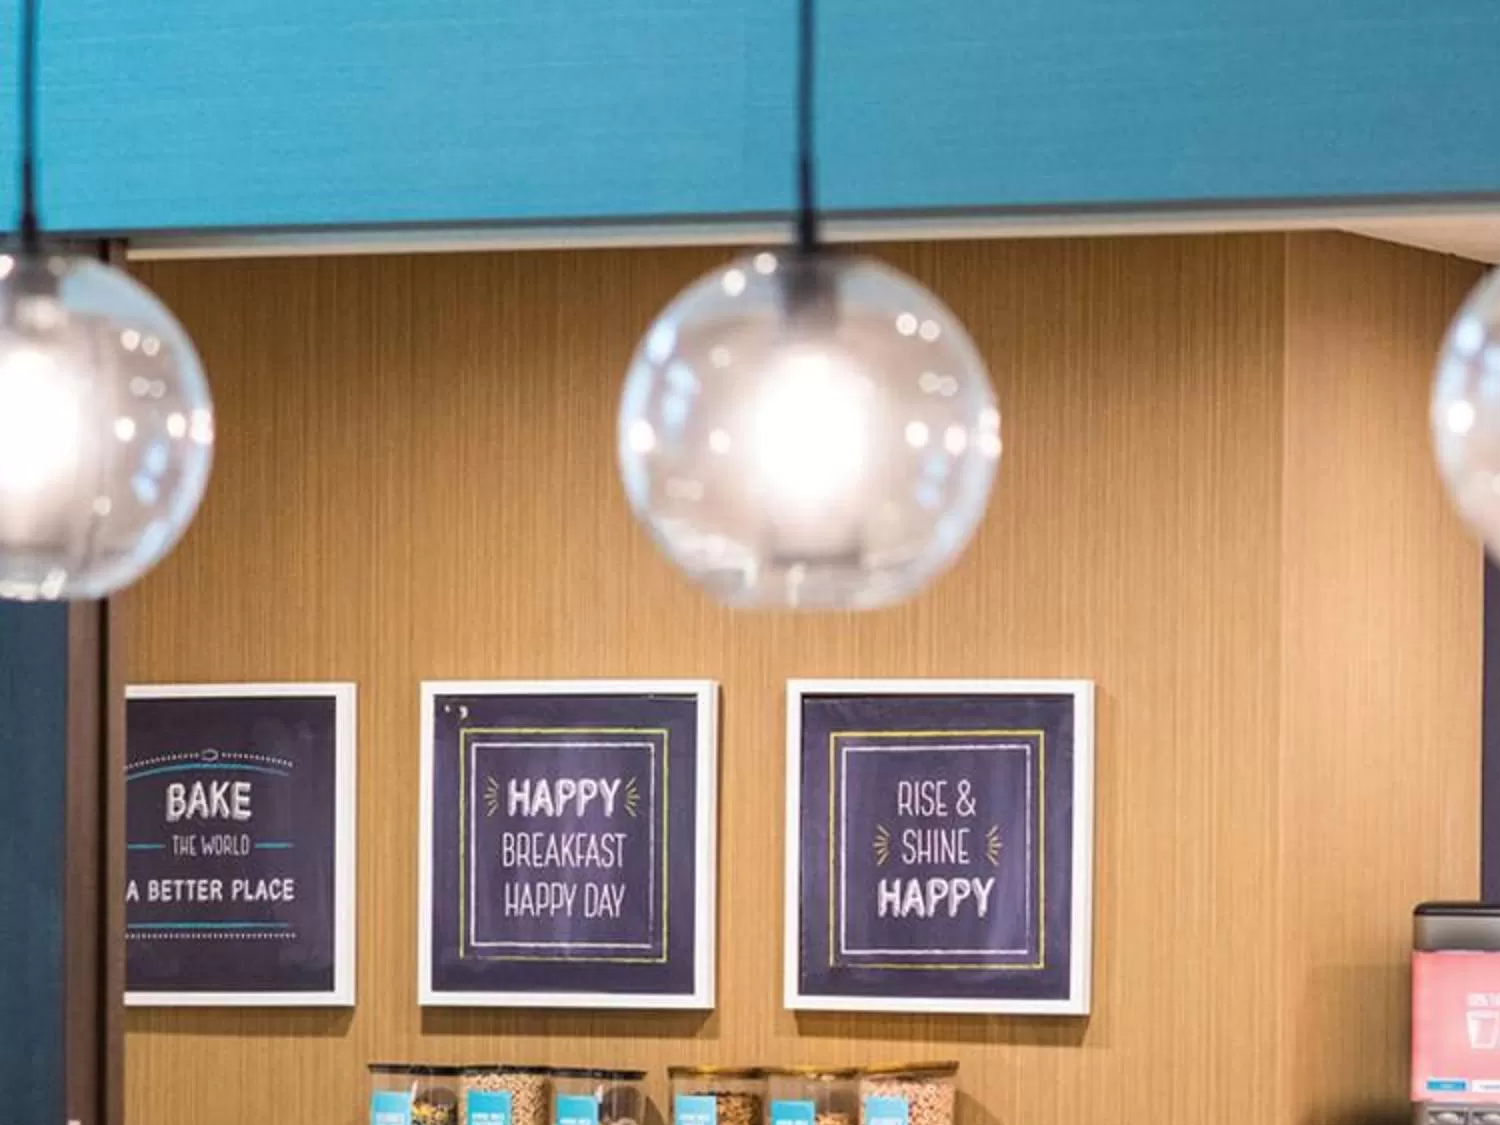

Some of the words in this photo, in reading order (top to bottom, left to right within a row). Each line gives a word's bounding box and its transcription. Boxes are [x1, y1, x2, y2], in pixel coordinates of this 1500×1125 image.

[165, 780, 253, 822] BAKE
[507, 777, 622, 818] HAPPY
[897, 780, 949, 817] RISE
[955, 779, 977, 817] &
[172, 833, 197, 856] THE
[201, 832, 250, 856] WORLD
[502, 831, 627, 869] BREAKFAST
[902, 827, 970, 865] SHINE
[126, 879, 140, 902] A
[147, 879, 223, 902] BETTER
[231, 878, 295, 902] PLACE
[504, 881, 577, 917] HAPPY
[584, 881, 626, 919] DAY
[877, 876, 996, 918] HAPPY
